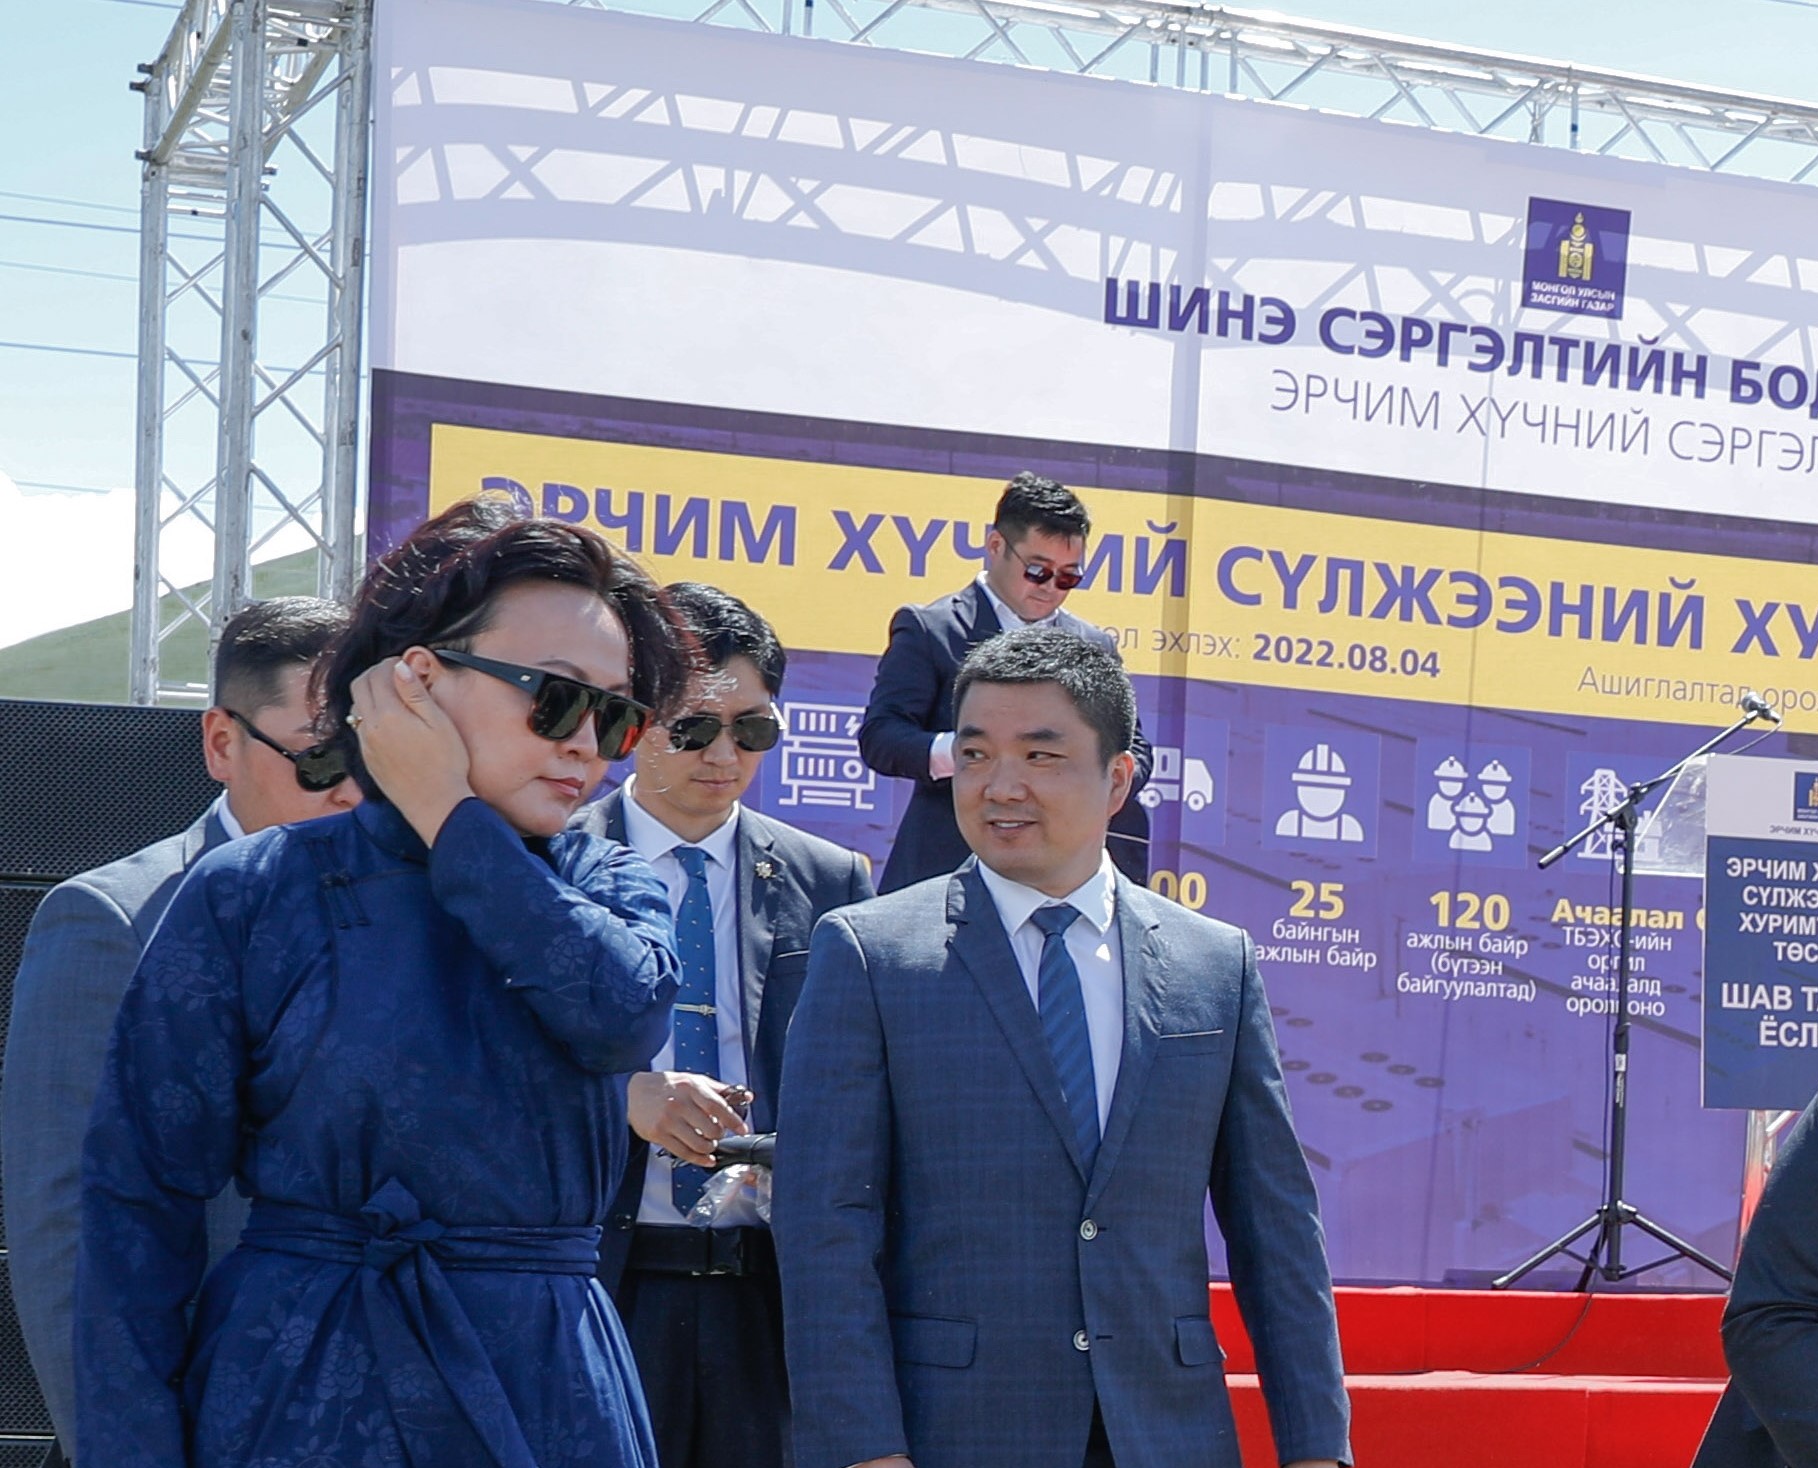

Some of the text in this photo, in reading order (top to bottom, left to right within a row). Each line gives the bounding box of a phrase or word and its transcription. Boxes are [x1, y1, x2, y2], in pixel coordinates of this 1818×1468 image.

[1103, 277, 1297, 344] ШИНЭ
[1318, 307, 1708, 399] СЭРГЭЛТИЙН
[1270, 369, 1440, 430] ЭРЧИМ
[1456, 394, 1651, 456] ХҮЧНИЙ
[827, 510, 1187, 598] ХҮЧИЙ
[1216, 546, 1705, 650] СҮЛЖЭЭНИЙ
[1252, 634, 1441, 678] 2022.08.04
[1726, 857, 1806, 881] ЭРЧИМ
[1150, 870, 1208, 911] 00
[1289, 880, 1345, 920] 25
[1429, 891, 1510, 931] 120
[1551, 898, 1684, 930] Ачаалал
[1272, 918, 1360, 944] байнгын
[1406, 932, 1529, 959] ажлын байр
[1256, 944, 1378, 972] ажлын байр
[1431, 951, 1503, 978] (бүтээн
[1397, 971, 1536, 1003] байгуулалтад)
[1571, 975, 1661, 997] ачааалд
[1721, 982, 1793, 1010] ШАВ
